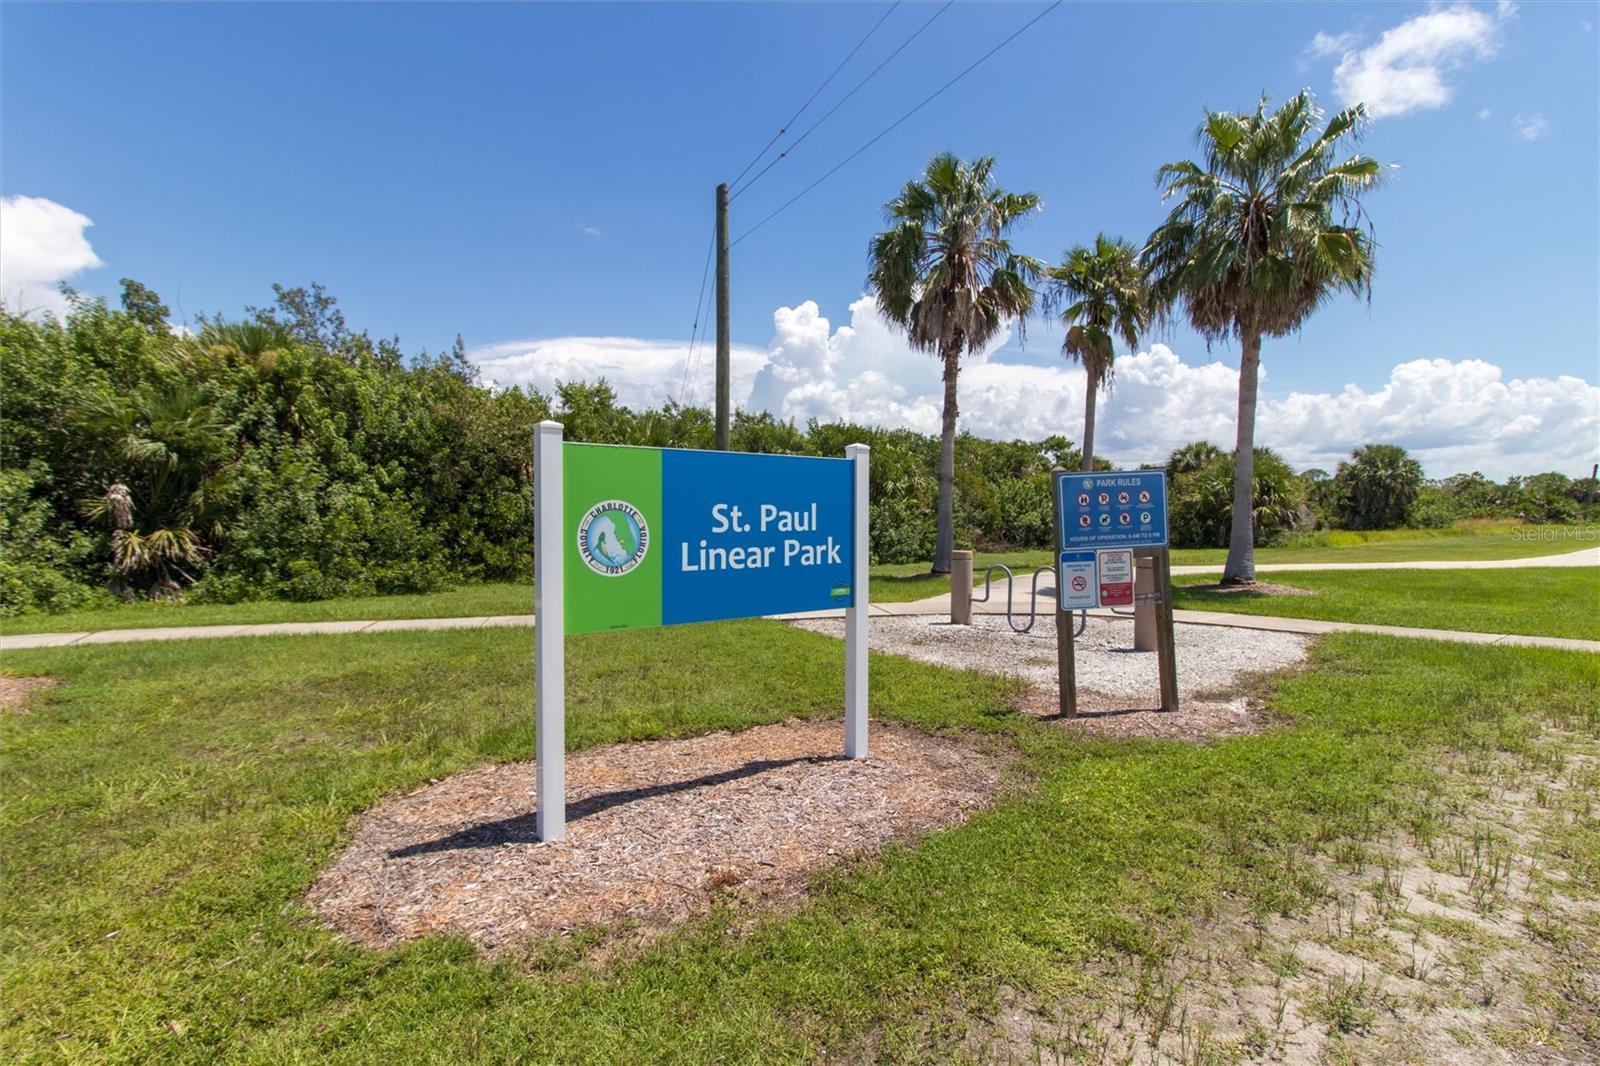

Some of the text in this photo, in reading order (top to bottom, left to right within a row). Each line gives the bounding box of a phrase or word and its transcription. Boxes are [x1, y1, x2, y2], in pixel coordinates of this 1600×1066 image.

[1096, 477, 1141, 487] PARK RULES
[591, 502, 637, 518] CHARLOTTE
[711, 502, 817, 533] St. Paul
[579, 529, 594, 564] COUNTY
[632, 526, 647, 564] FLORIDA
[681, 536, 842, 572] Linear Park
[606, 566, 624, 574] 1921
